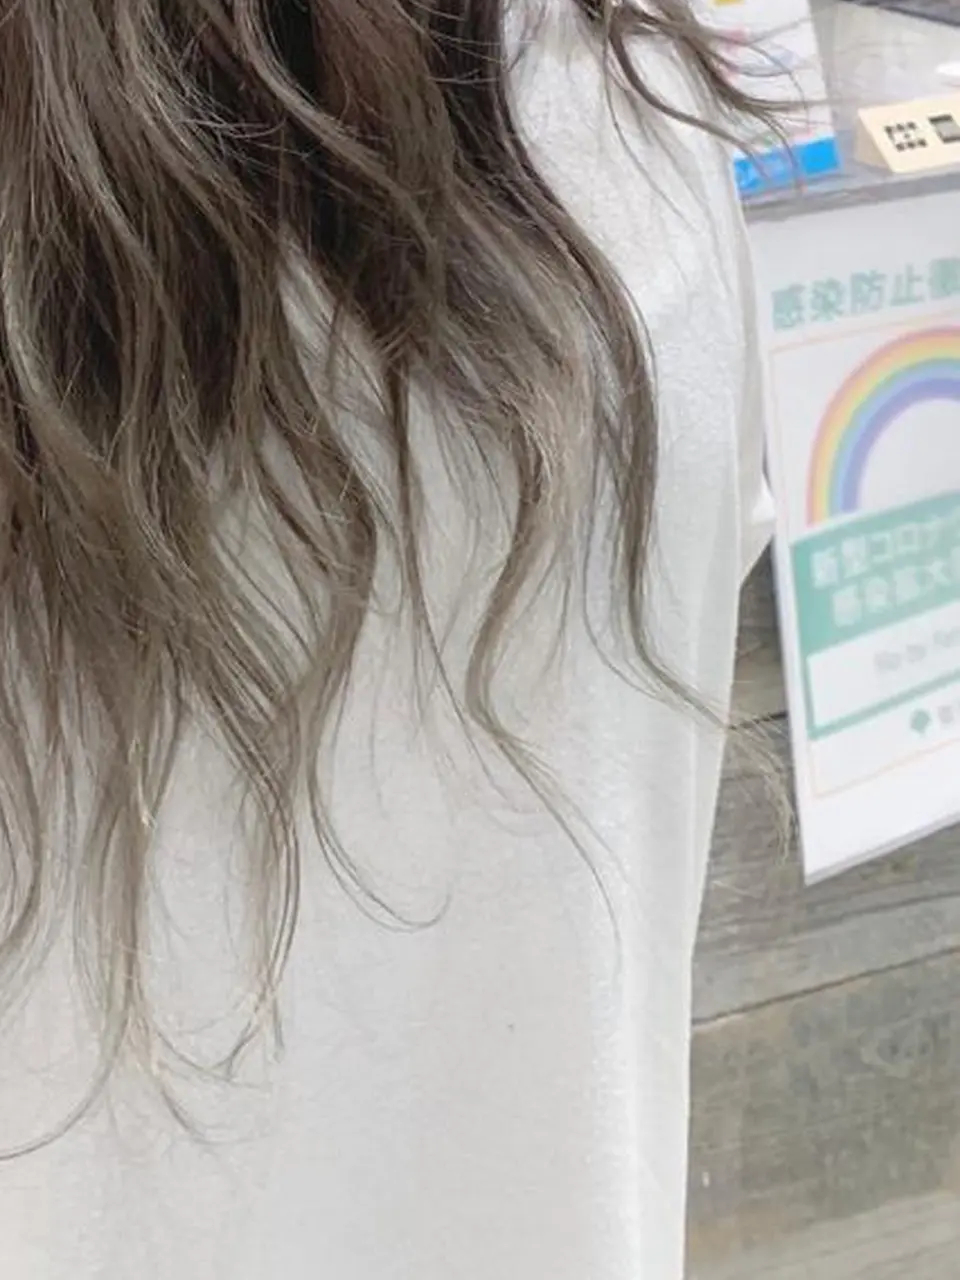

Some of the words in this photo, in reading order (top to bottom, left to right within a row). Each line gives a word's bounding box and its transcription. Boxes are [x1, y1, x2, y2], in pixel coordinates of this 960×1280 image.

[810, 516, 960, 589] 新型コロナ
